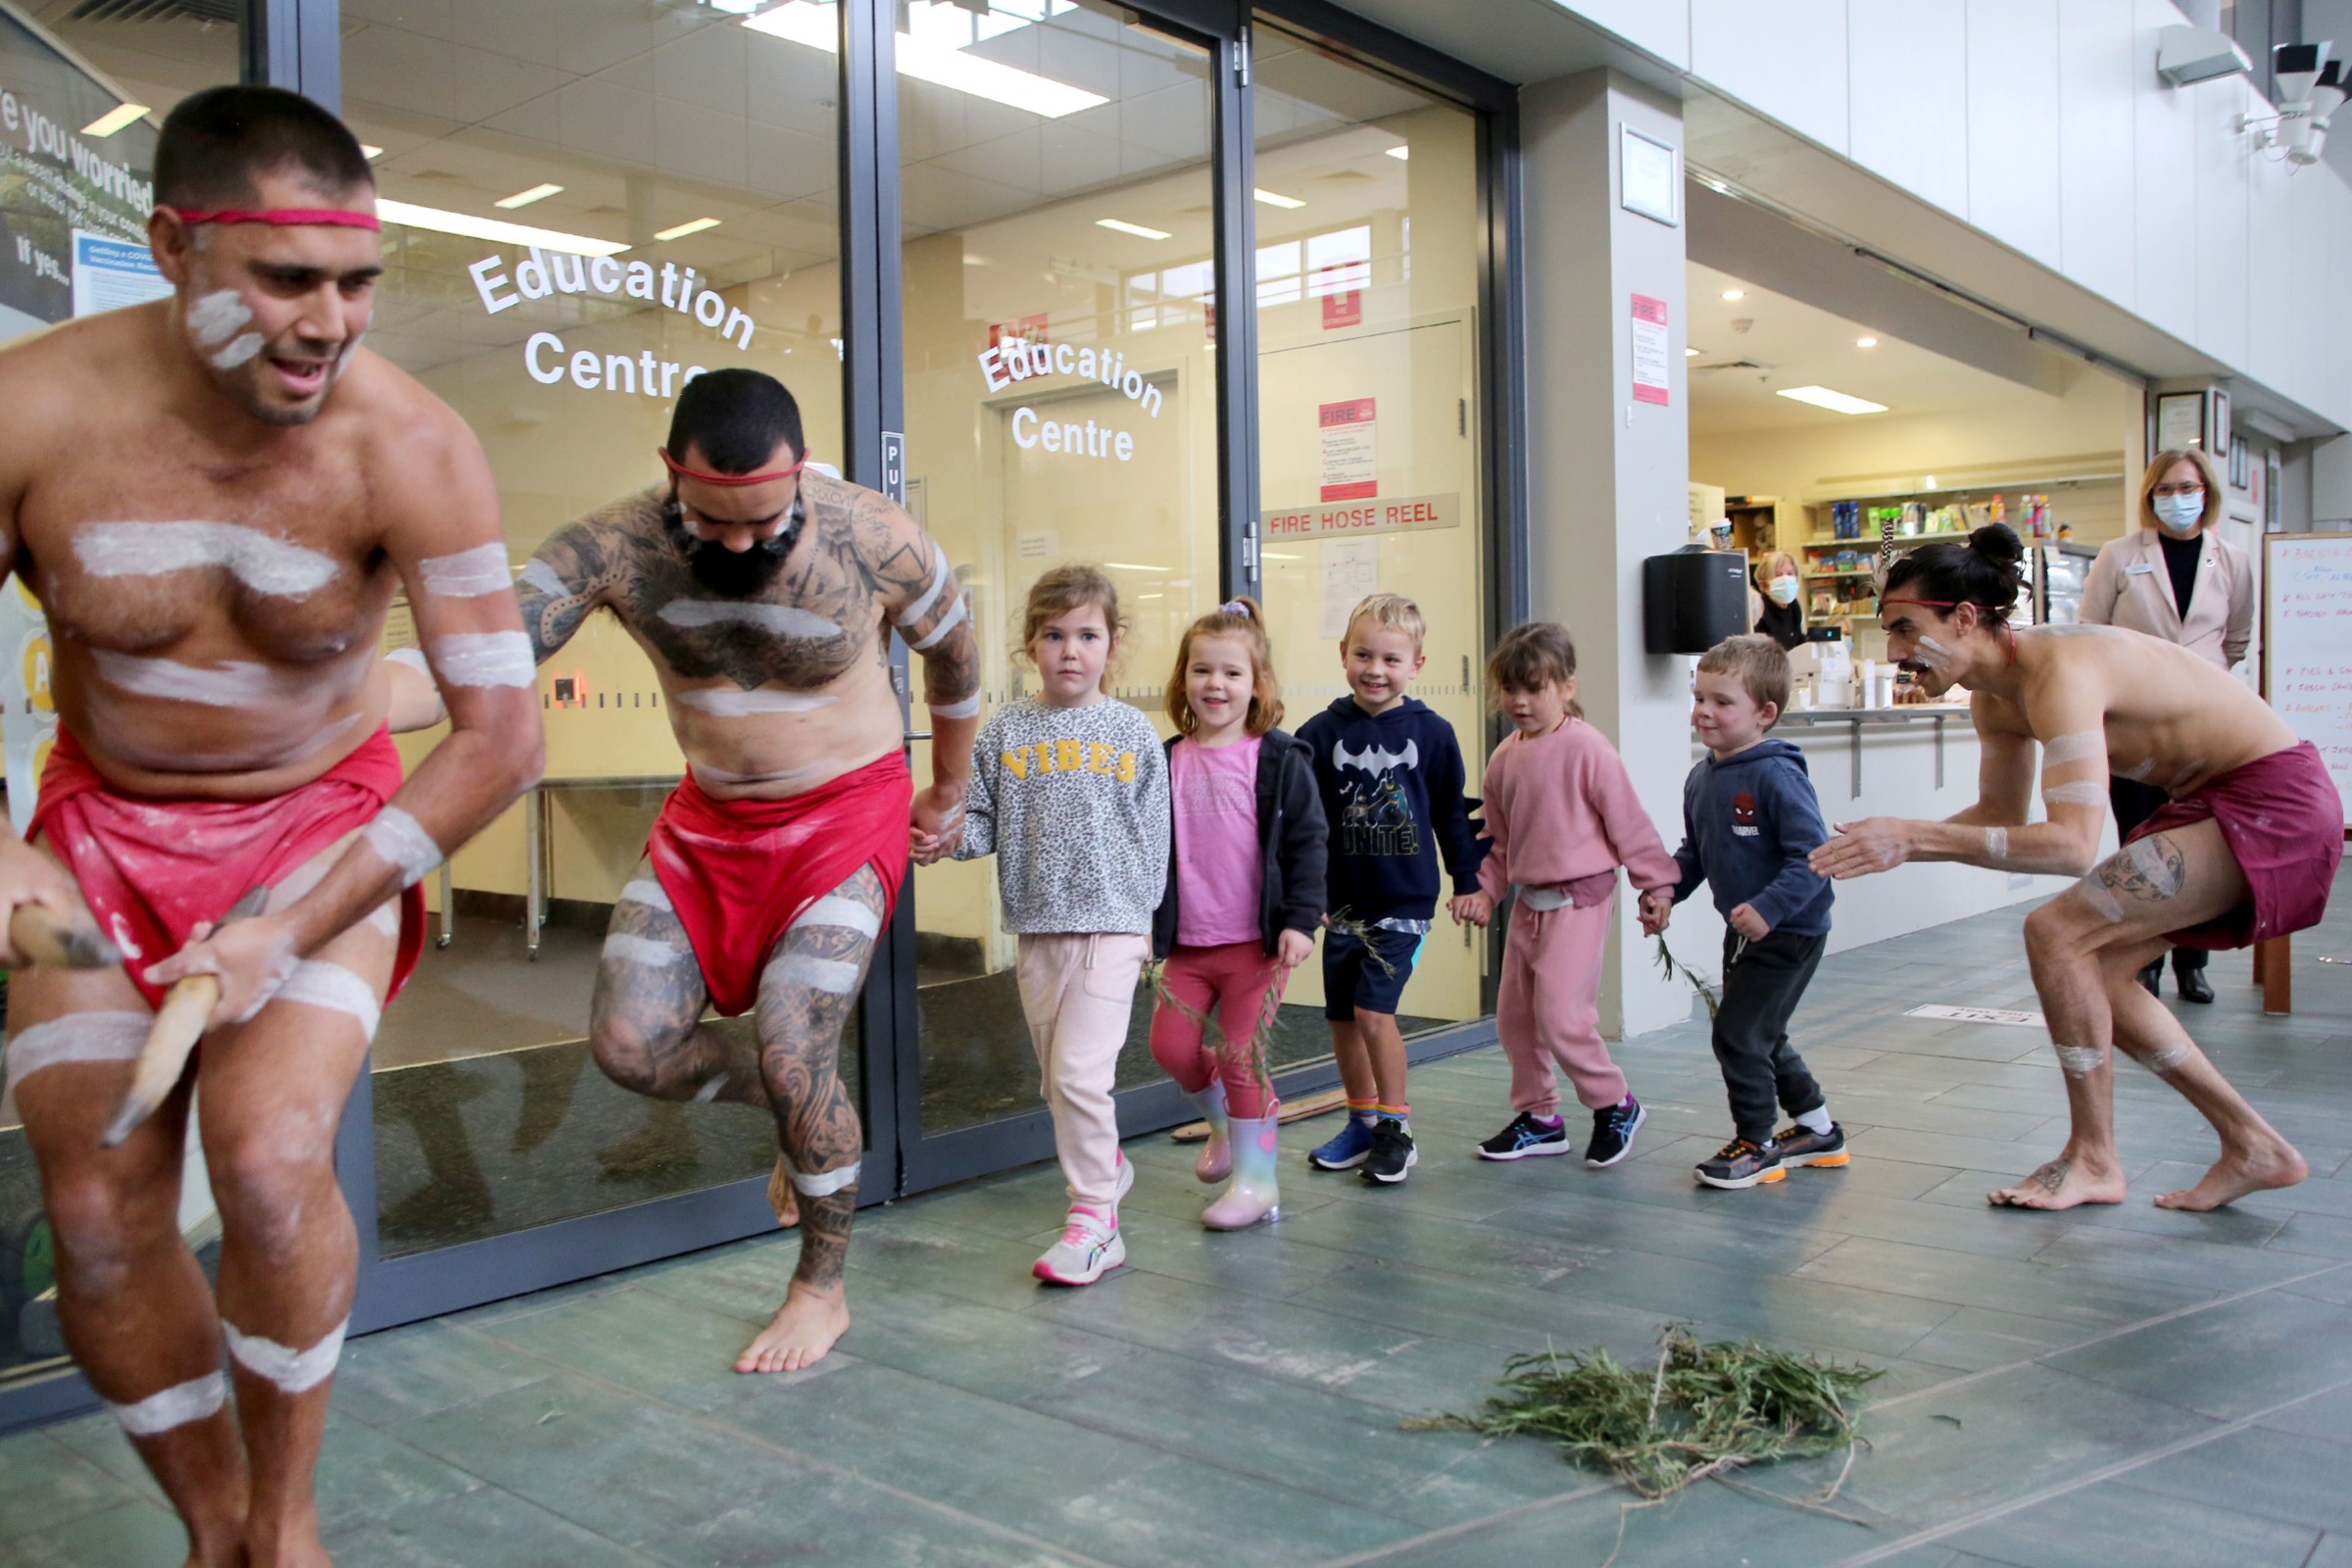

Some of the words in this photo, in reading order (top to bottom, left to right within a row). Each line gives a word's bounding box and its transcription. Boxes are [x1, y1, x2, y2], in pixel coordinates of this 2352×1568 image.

[0, 88, 19, 131] e
[22, 104, 68, 163] you
[70, 135, 154, 218] worried
[16, 235, 31, 265] If
[468, 245, 755, 351] Education
[978, 337, 1163, 418] Education
[1011, 407, 1134, 462] Centre
[1321, 408, 1356, 423] FIRE
[1270, 514, 1311, 534] FIRE
[1321, 508, 1376, 530] HOSE
[1386, 503, 1439, 524] REEL
[1000, 738, 1137, 783] VIBES
[1341, 823, 1420, 856] UNITE!
[1732, 825, 1760, 836] MARVEL
